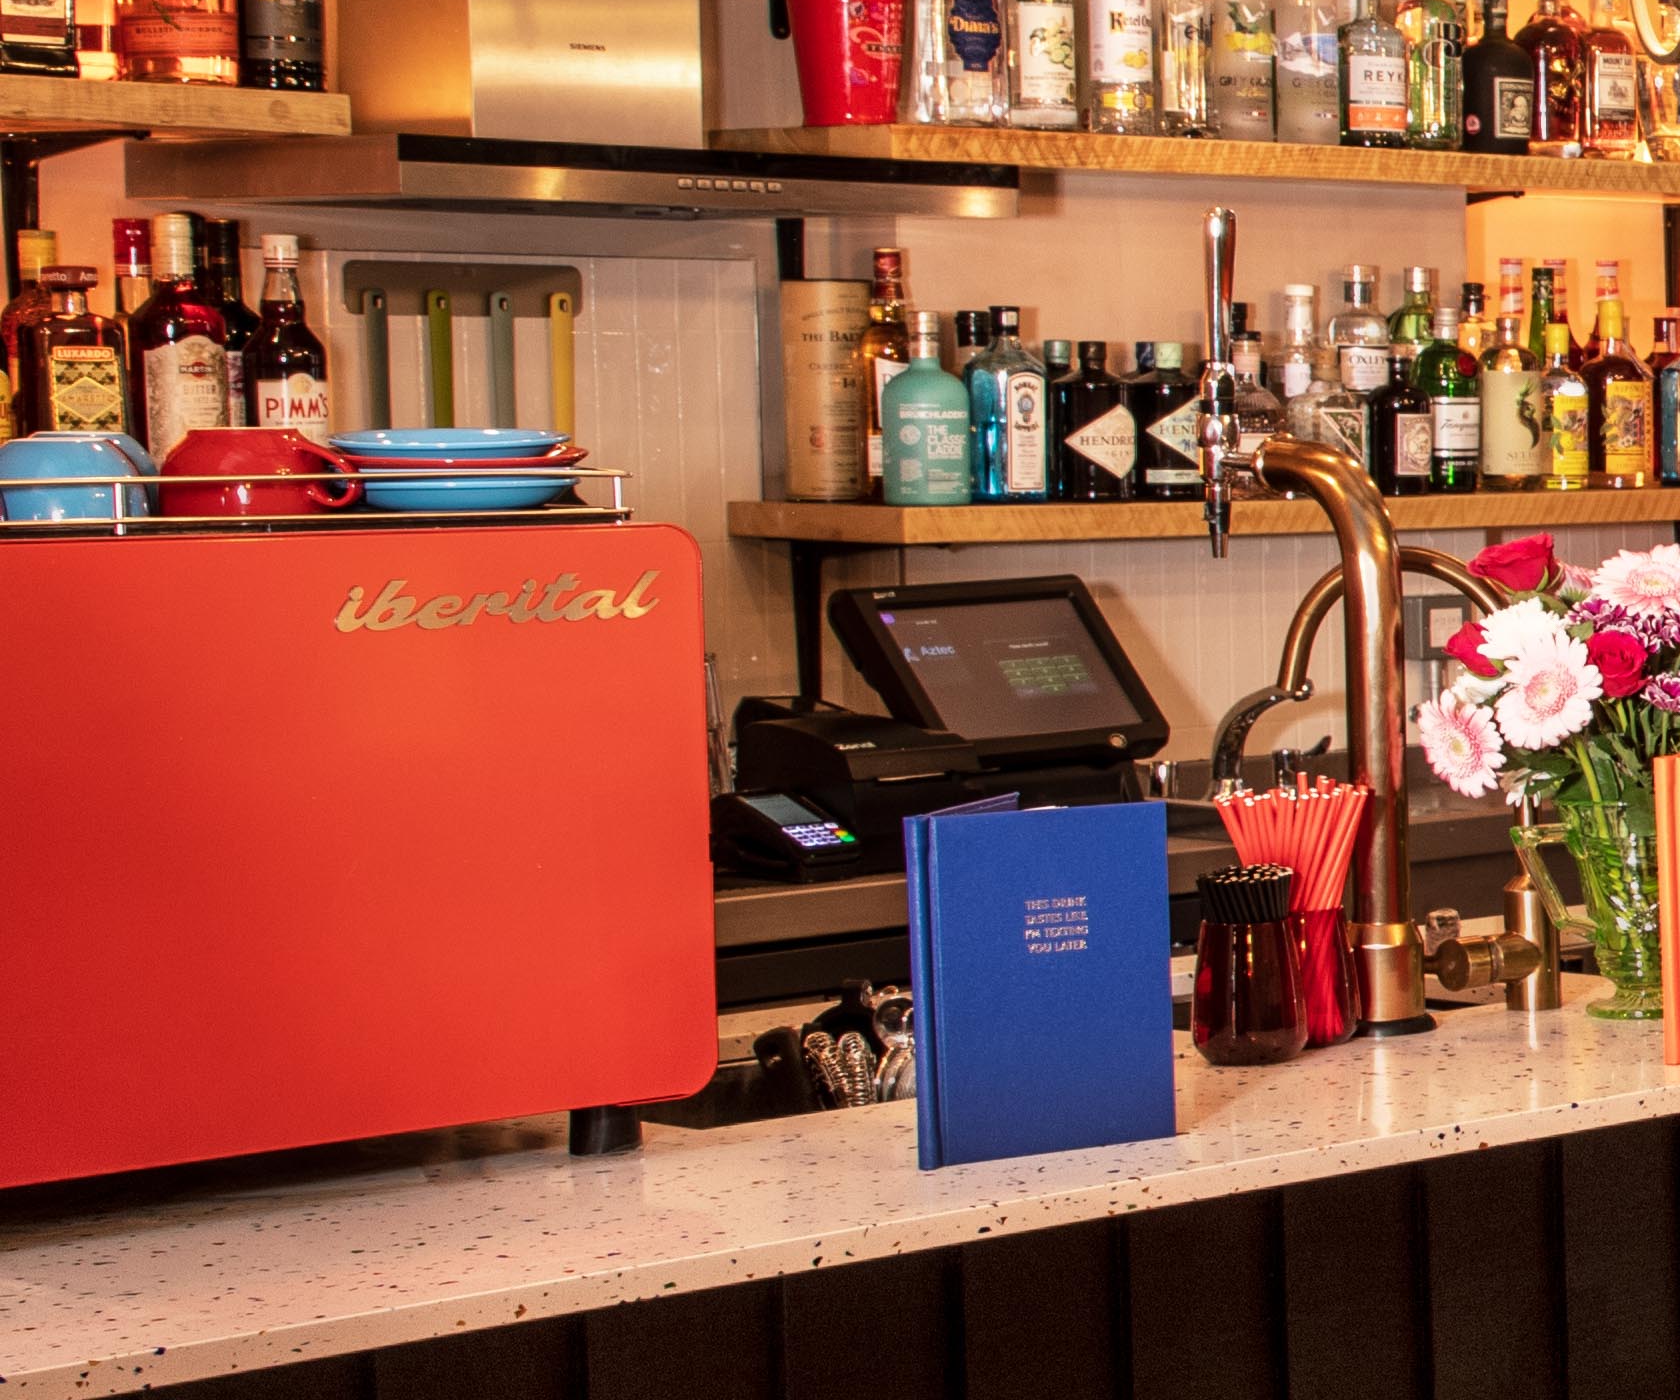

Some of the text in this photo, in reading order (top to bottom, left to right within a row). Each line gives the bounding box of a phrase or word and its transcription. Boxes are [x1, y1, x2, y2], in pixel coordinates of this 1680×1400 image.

[56, 349, 111, 360] LUXARDO
[265, 393, 329, 419] PIMM'S
[927, 424, 948, 434] THE
[334, 569, 661, 634] iberital
[920, 645, 956, 658] Aztec
